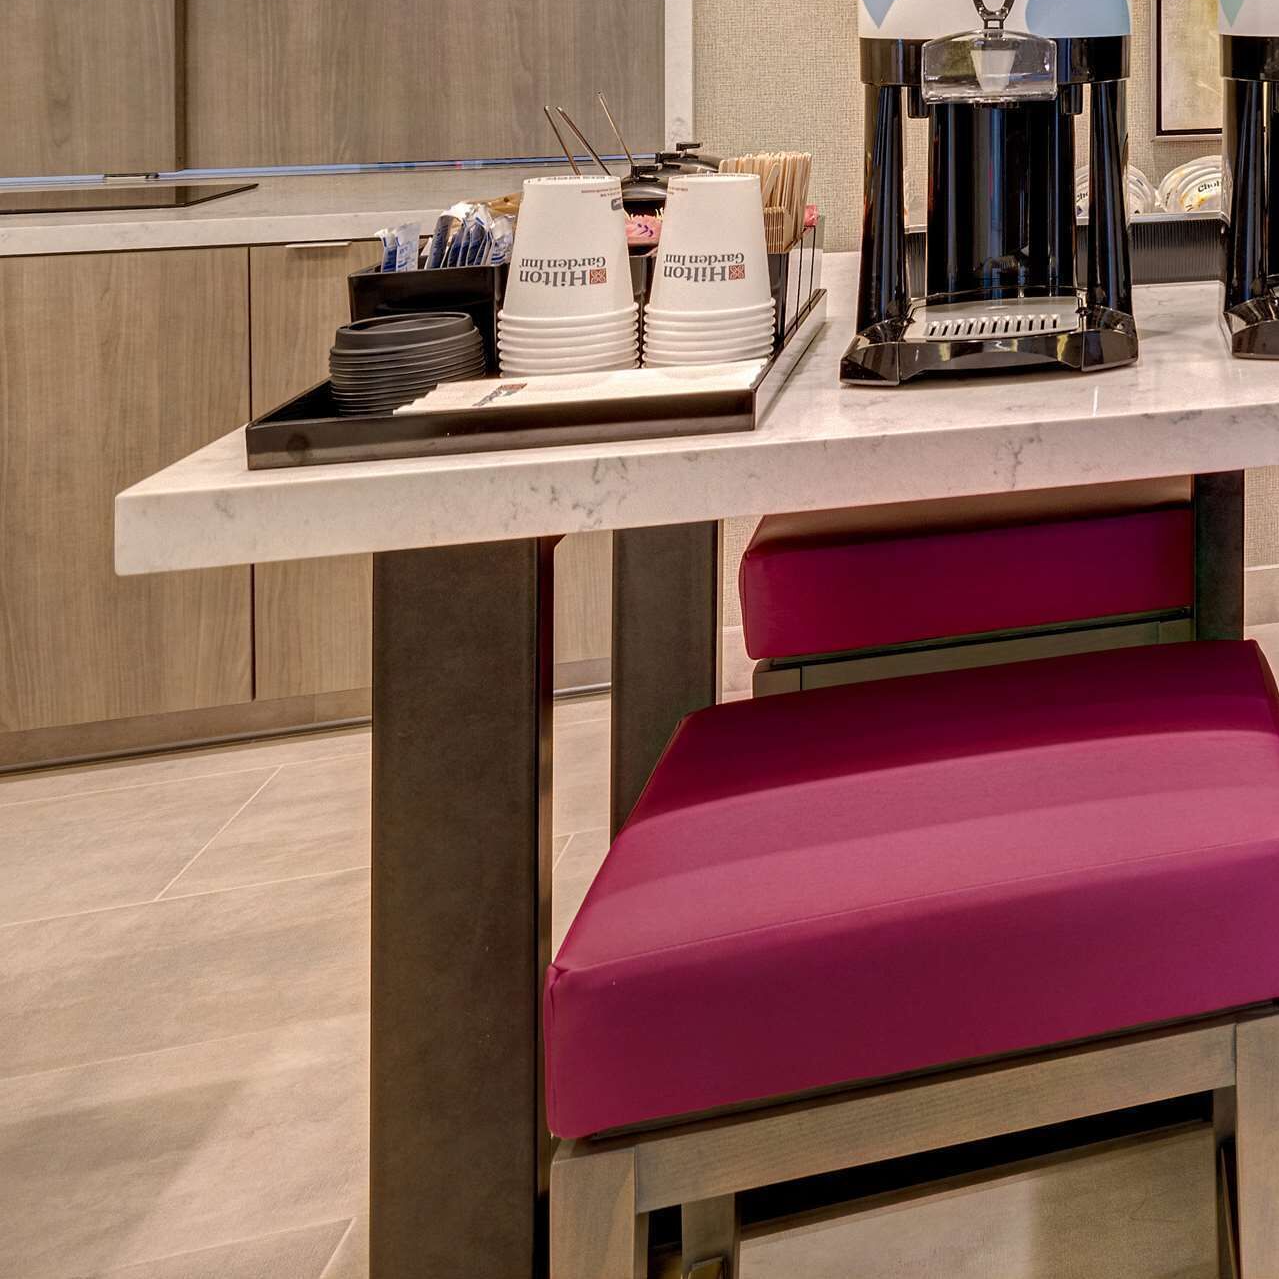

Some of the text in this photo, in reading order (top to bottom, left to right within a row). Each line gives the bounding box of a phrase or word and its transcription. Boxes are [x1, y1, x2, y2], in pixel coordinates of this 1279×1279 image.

[521, 257, 607, 270] Garden Inn
[665, 252, 745, 266] Garden Inn
[520, 270, 587, 287] Hilton
[663, 265, 726, 282] Hilton
